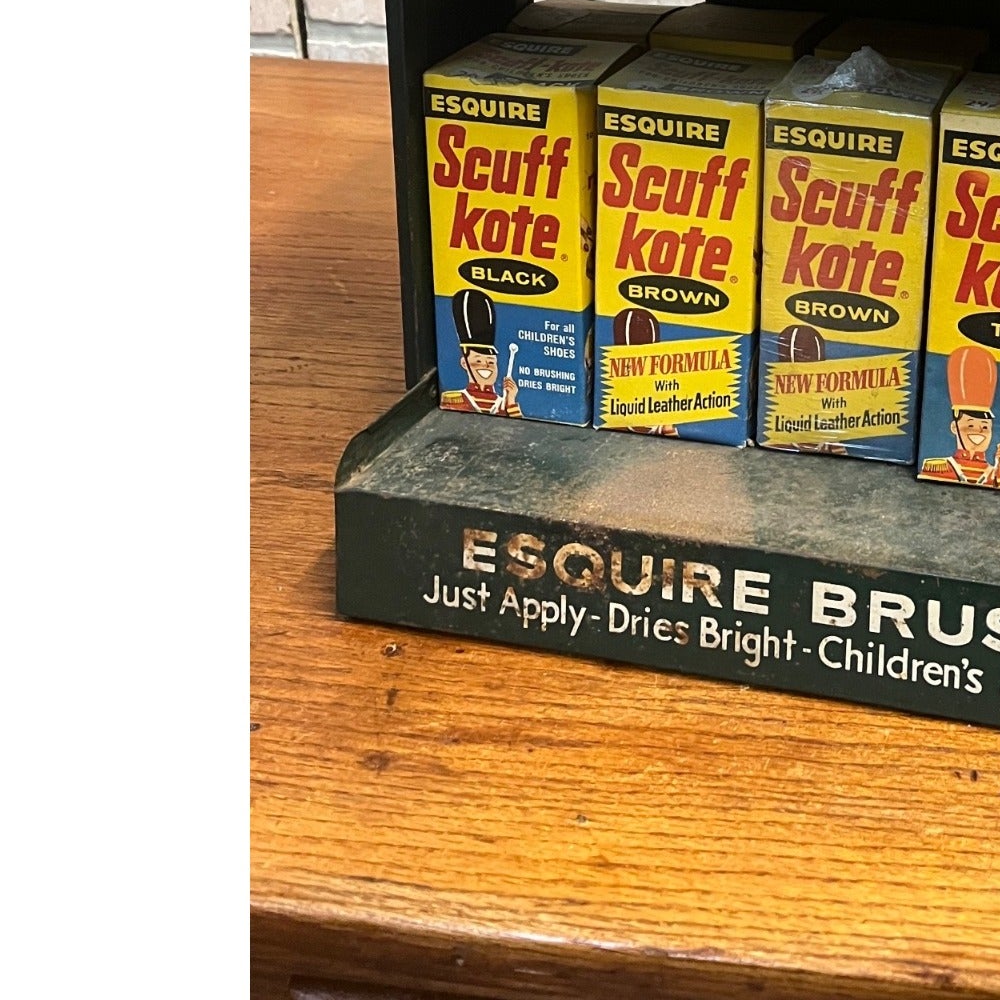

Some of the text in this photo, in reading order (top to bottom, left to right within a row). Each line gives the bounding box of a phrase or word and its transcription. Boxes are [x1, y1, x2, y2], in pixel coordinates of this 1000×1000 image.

[430, 94, 541, 122] ESQUIRE
[604, 112, 720, 143] ESQUIRE
[773, 125, 894, 155] ESQUIRE
[433, 123, 572, 199] Scuff
[602, 142, 751, 221] Scuff
[770, 156, 924, 235] Scuff
[449, 192, 561, 260] kote
[614, 212, 733, 282] kote
[781, 226, 905, 297] kote
[471, 266, 547, 288] BLACK
[628, 285, 720, 307] BROWN
[544, 321, 575, 332] For all
[795, 300, 890, 325] BROWN
[518, 330, 575, 347] CHILDREN'S
[543, 345, 576, 359] SHOES
[519, 366, 576, 381] NO BRUSHING
[609, 349, 732, 379] NEW FORMULA
[518, 378, 576, 394] DRIES BRIGHT
[655, 379, 679, 392] With
[774, 366, 901, 395] NEW FORMULA
[610, 392, 731, 417] Liquid Leather Action
[821, 396, 847, 409] With
[774, 413, 812, 434] Liquid
[861, 409, 900, 426] Action
[462, 527, 771, 616] ESQUIRE
[422, 575, 490, 612] Just
[499, 586, 587, 637] Apply
[609, 602, 689, 645] Dries
[700, 616, 797, 668] Bright
[818, 635, 983, 695] Children's
